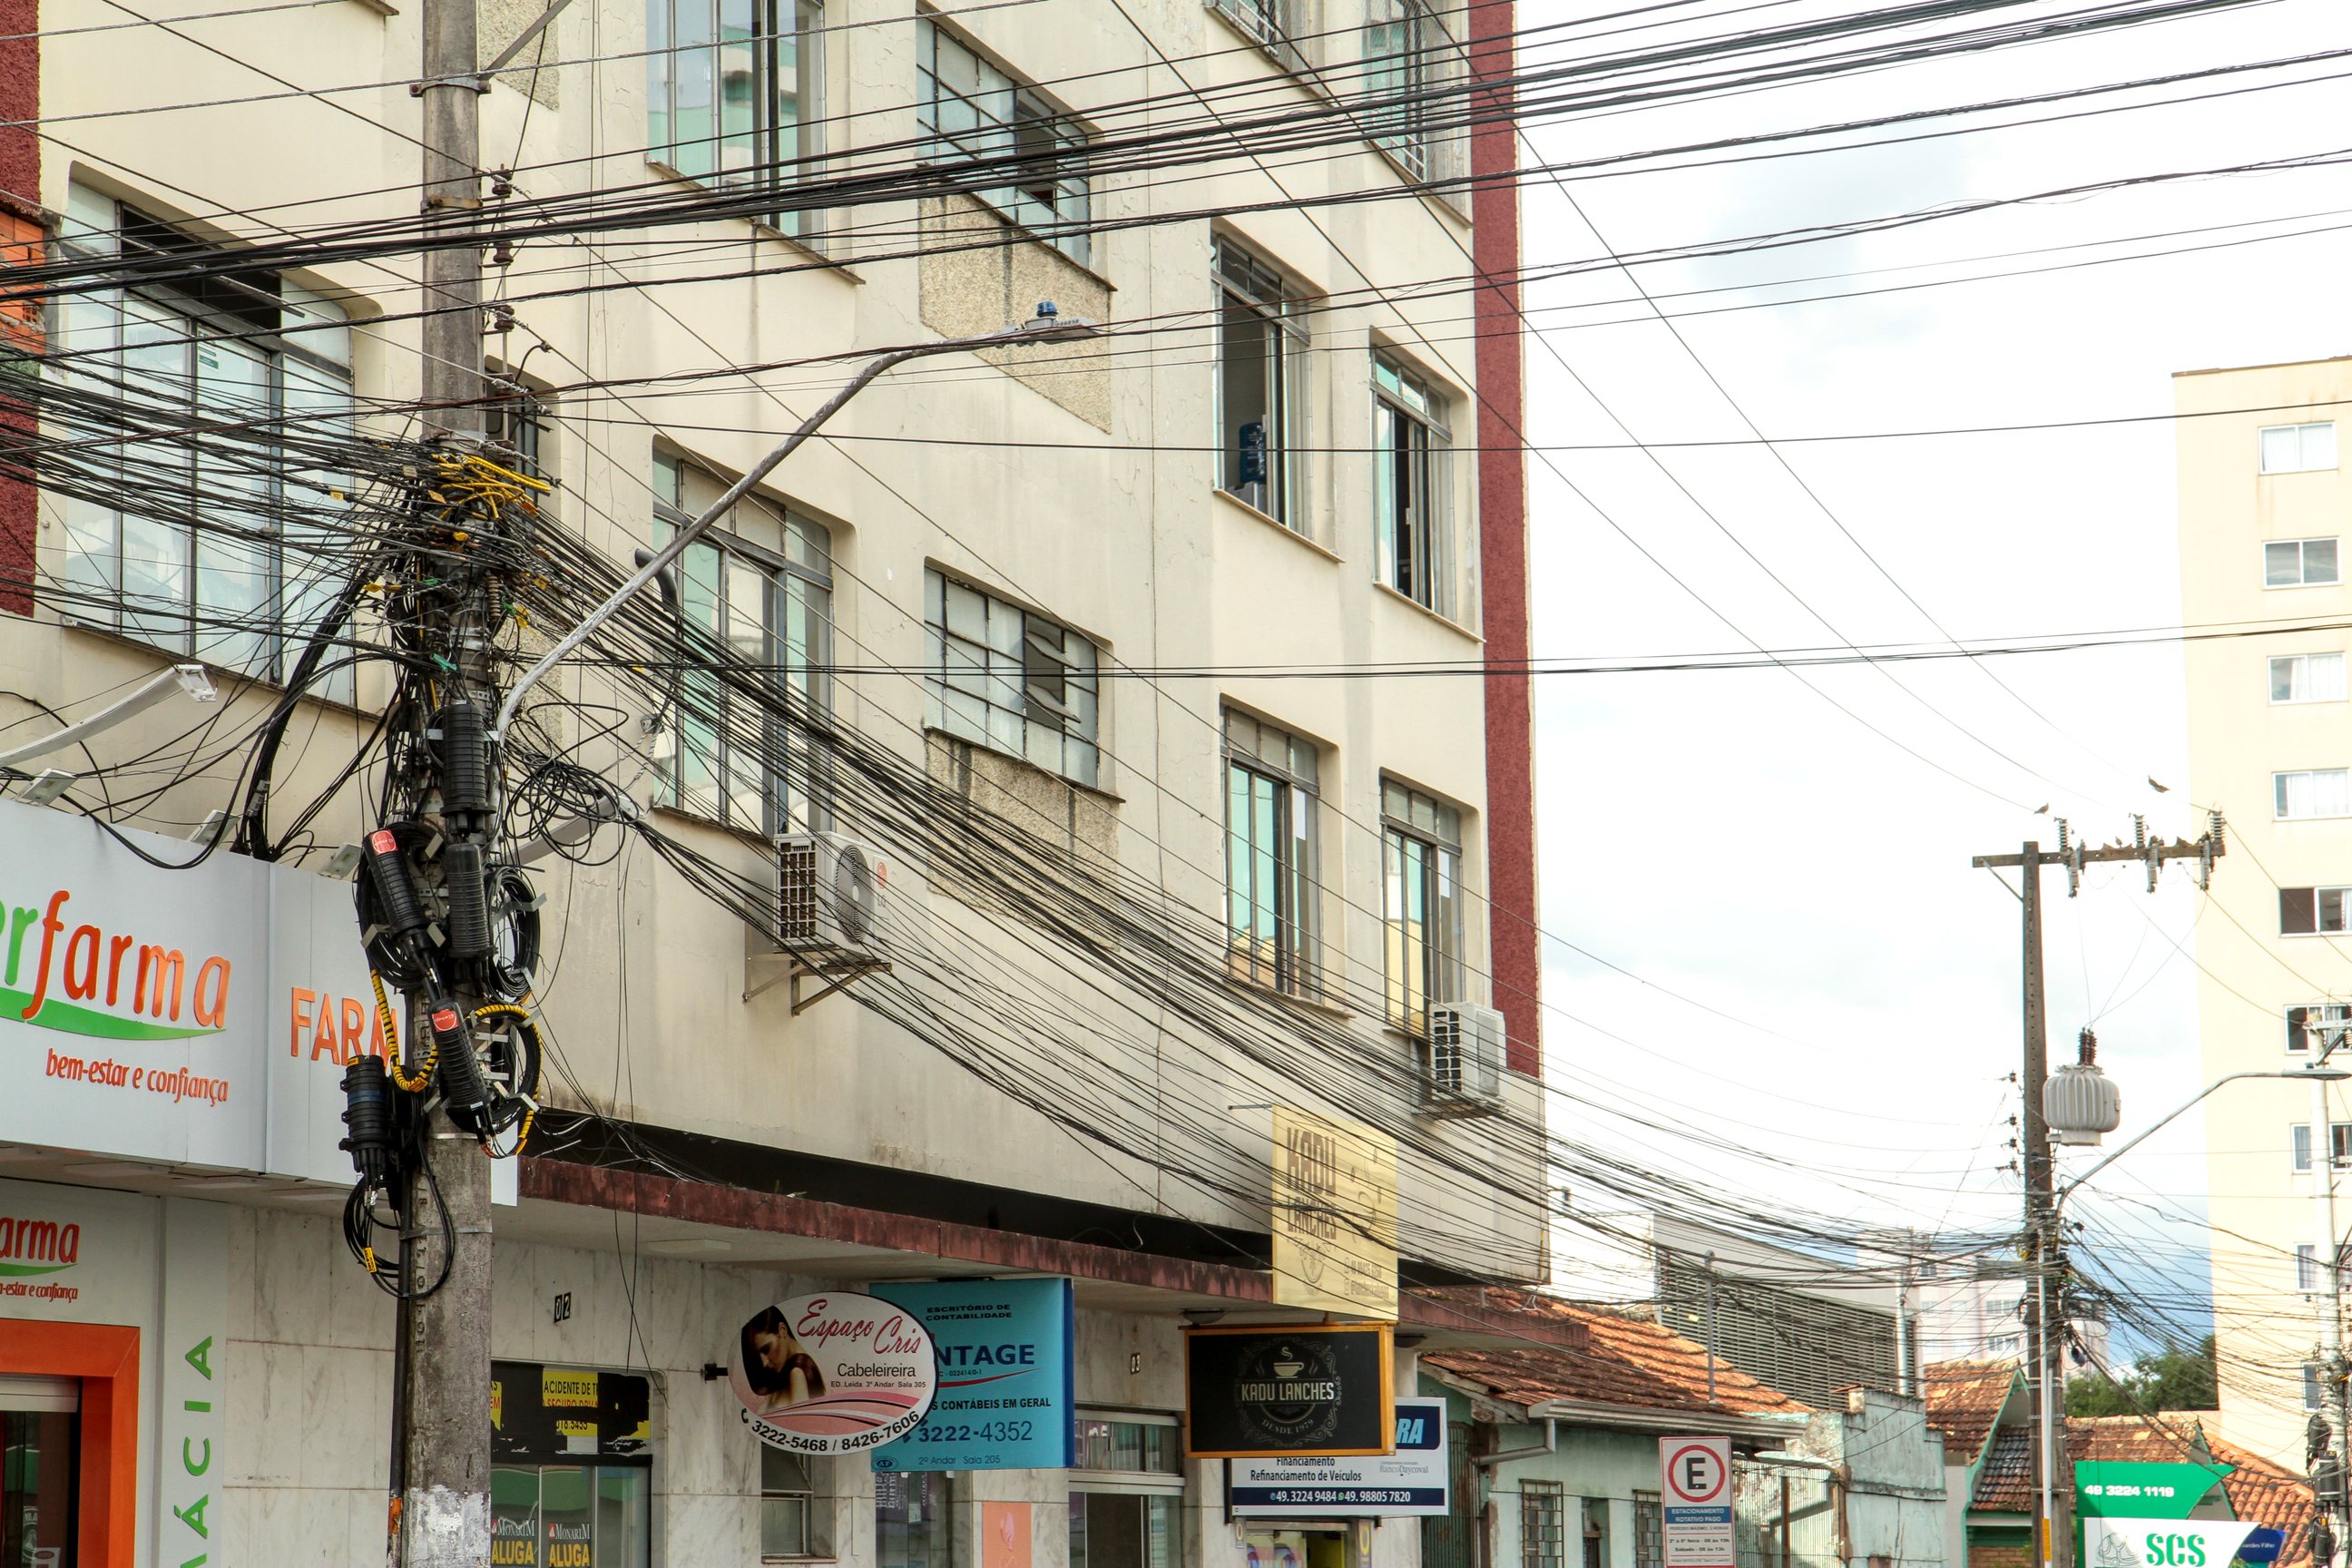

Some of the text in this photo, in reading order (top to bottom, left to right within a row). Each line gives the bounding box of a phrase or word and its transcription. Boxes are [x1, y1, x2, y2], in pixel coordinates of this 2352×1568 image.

[0, 890, 230, 1029] rfarma
[46, 1048, 229, 1107] bem-estar e confiança
[1287, 1127, 1337, 1197] KADU
[1287, 1194, 1337, 1240] LANCHES
[29, 1285, 34, 1297] e
[36, 1282, 78, 1303] confiança
[554, 1294, 571, 1321] 02
[926, 1304, 994, 1313] ESCRITÓRIO
[926, 1312, 1013, 1321] CONTABILIDADE
[797, 1298, 921, 1355] Espaço Cris
[837, 1362, 916, 1377] Cabeleireira
[544, 1380, 580, 1396] ACIDENTE
[582, 1382, 592, 1396] DE
[875, 1380, 895, 1388] Andar
[1241, 1382, 1335, 1401] KADU LANCHES
[942, 1397, 999, 1411] CONTÁBEIS
[1003, 1399, 1017, 1408] EM
[1020, 1397, 1052, 1408] GERAL
[751, 1419, 828, 1452] 3222-5468
[841, 1410, 920, 1451] 8426-7606
[918, 1420, 1033, 1443] 3222-4352
[1261, 1417, 1293, 1435] DESDE
[1395, 1417, 1424, 1445] RA
[931, 1455, 956, 1465] Andar
[963, 1455, 983, 1465] Sala
[985, 1455, 1001, 1465] 205
[1277, 1456, 1335, 1467] Financiamento
[1250, 1469, 1362, 1482] Refinanciamento de Veículos
[1686, 1457, 1707, 1489] E
[1291, 1491, 1314, 1503] 3224
[1315, 1491, 1337, 1503] 9484
[1360, 1491, 1387, 1503] 98805
[1389, 1491, 1411, 1503] 7820
[2085, 1485, 2175, 1497] 49 3224 1119
[491, 1541, 535, 1565] ALUGA
[549, 1544, 591, 1568] ALUGA
[2146, 1533, 2206, 1567] SCS
